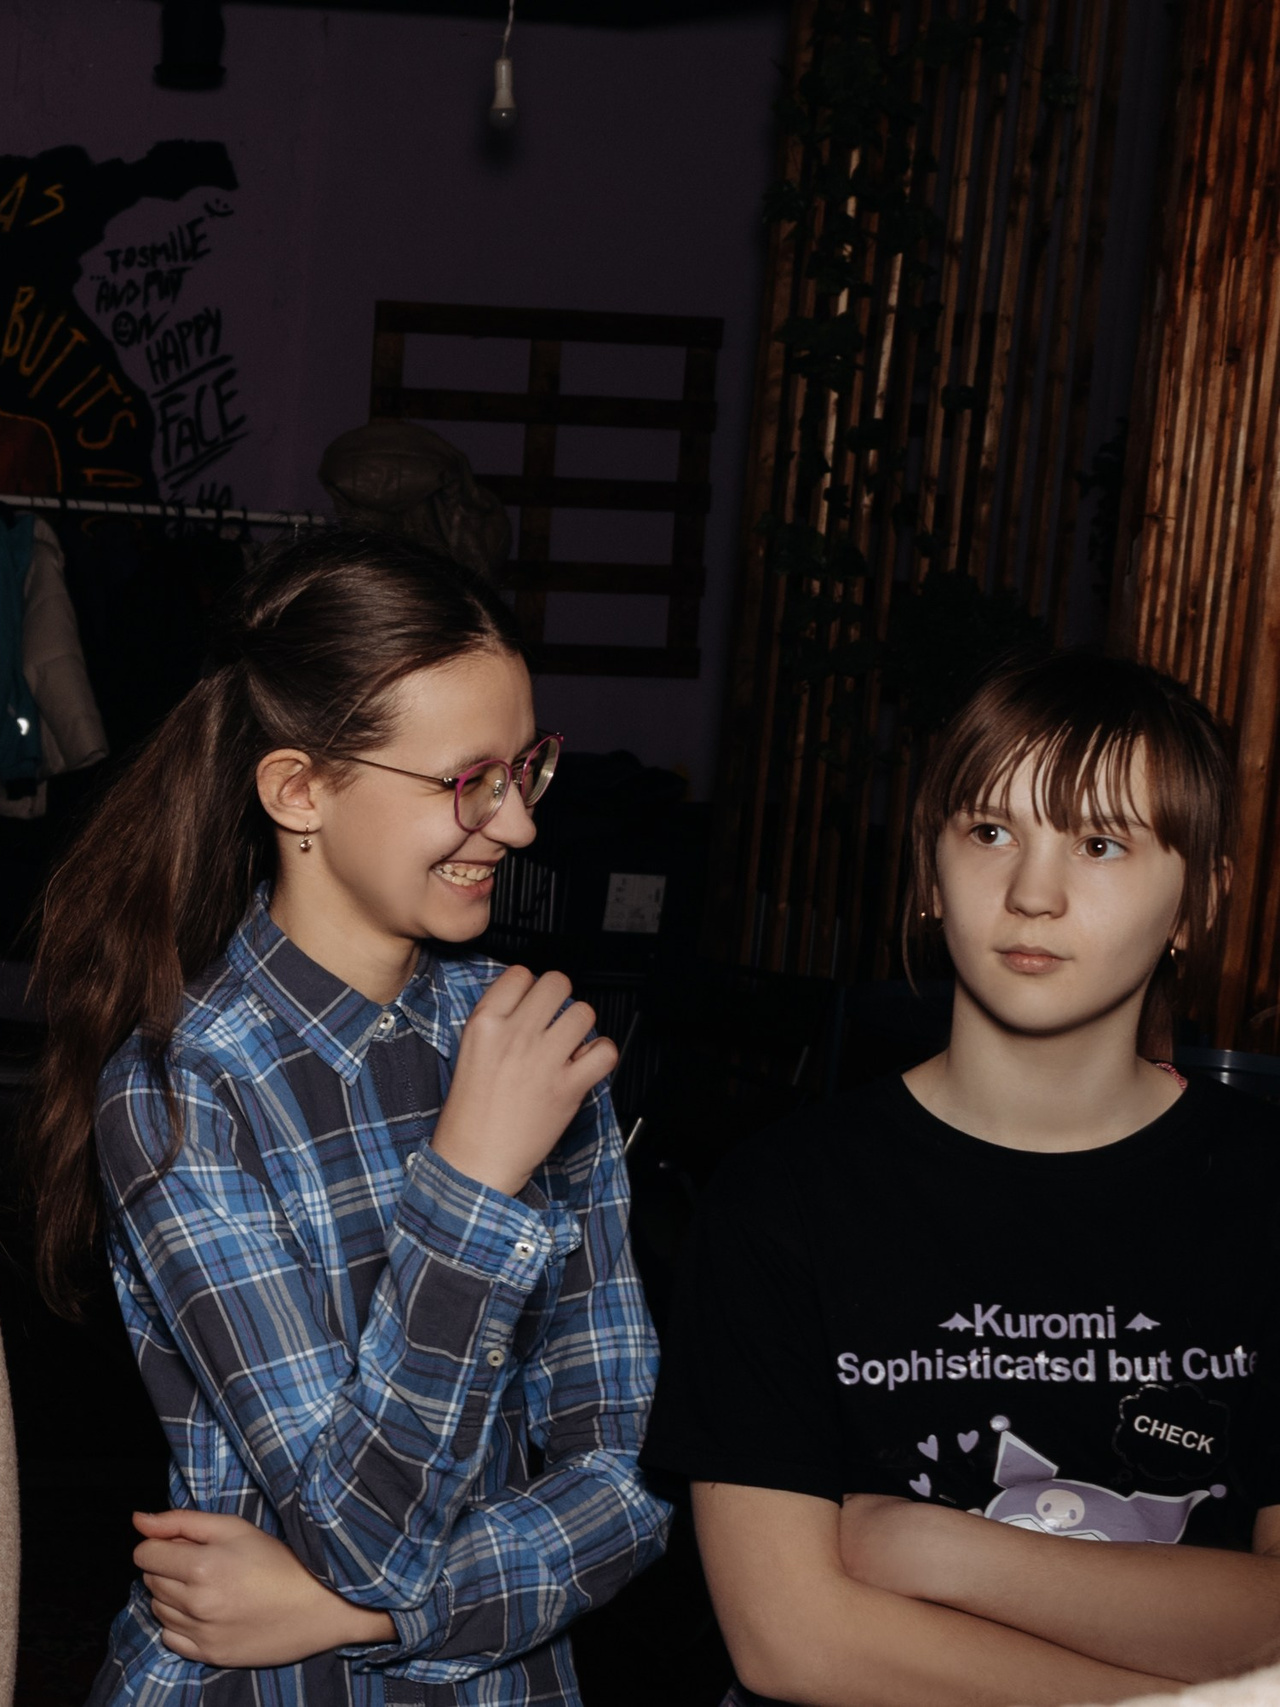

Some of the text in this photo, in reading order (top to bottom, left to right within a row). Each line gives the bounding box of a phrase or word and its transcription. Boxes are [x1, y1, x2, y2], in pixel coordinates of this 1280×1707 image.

[0, 285, 90, 400] BUT
[144, 307, 221, 385] HAPPY
[158, 368, 247, 468] FACE
[973, 1303, 1117, 1340] Kuromi
[1108, 1348, 1174, 1383] but
[1133, 1414, 1215, 1455] CHECK
